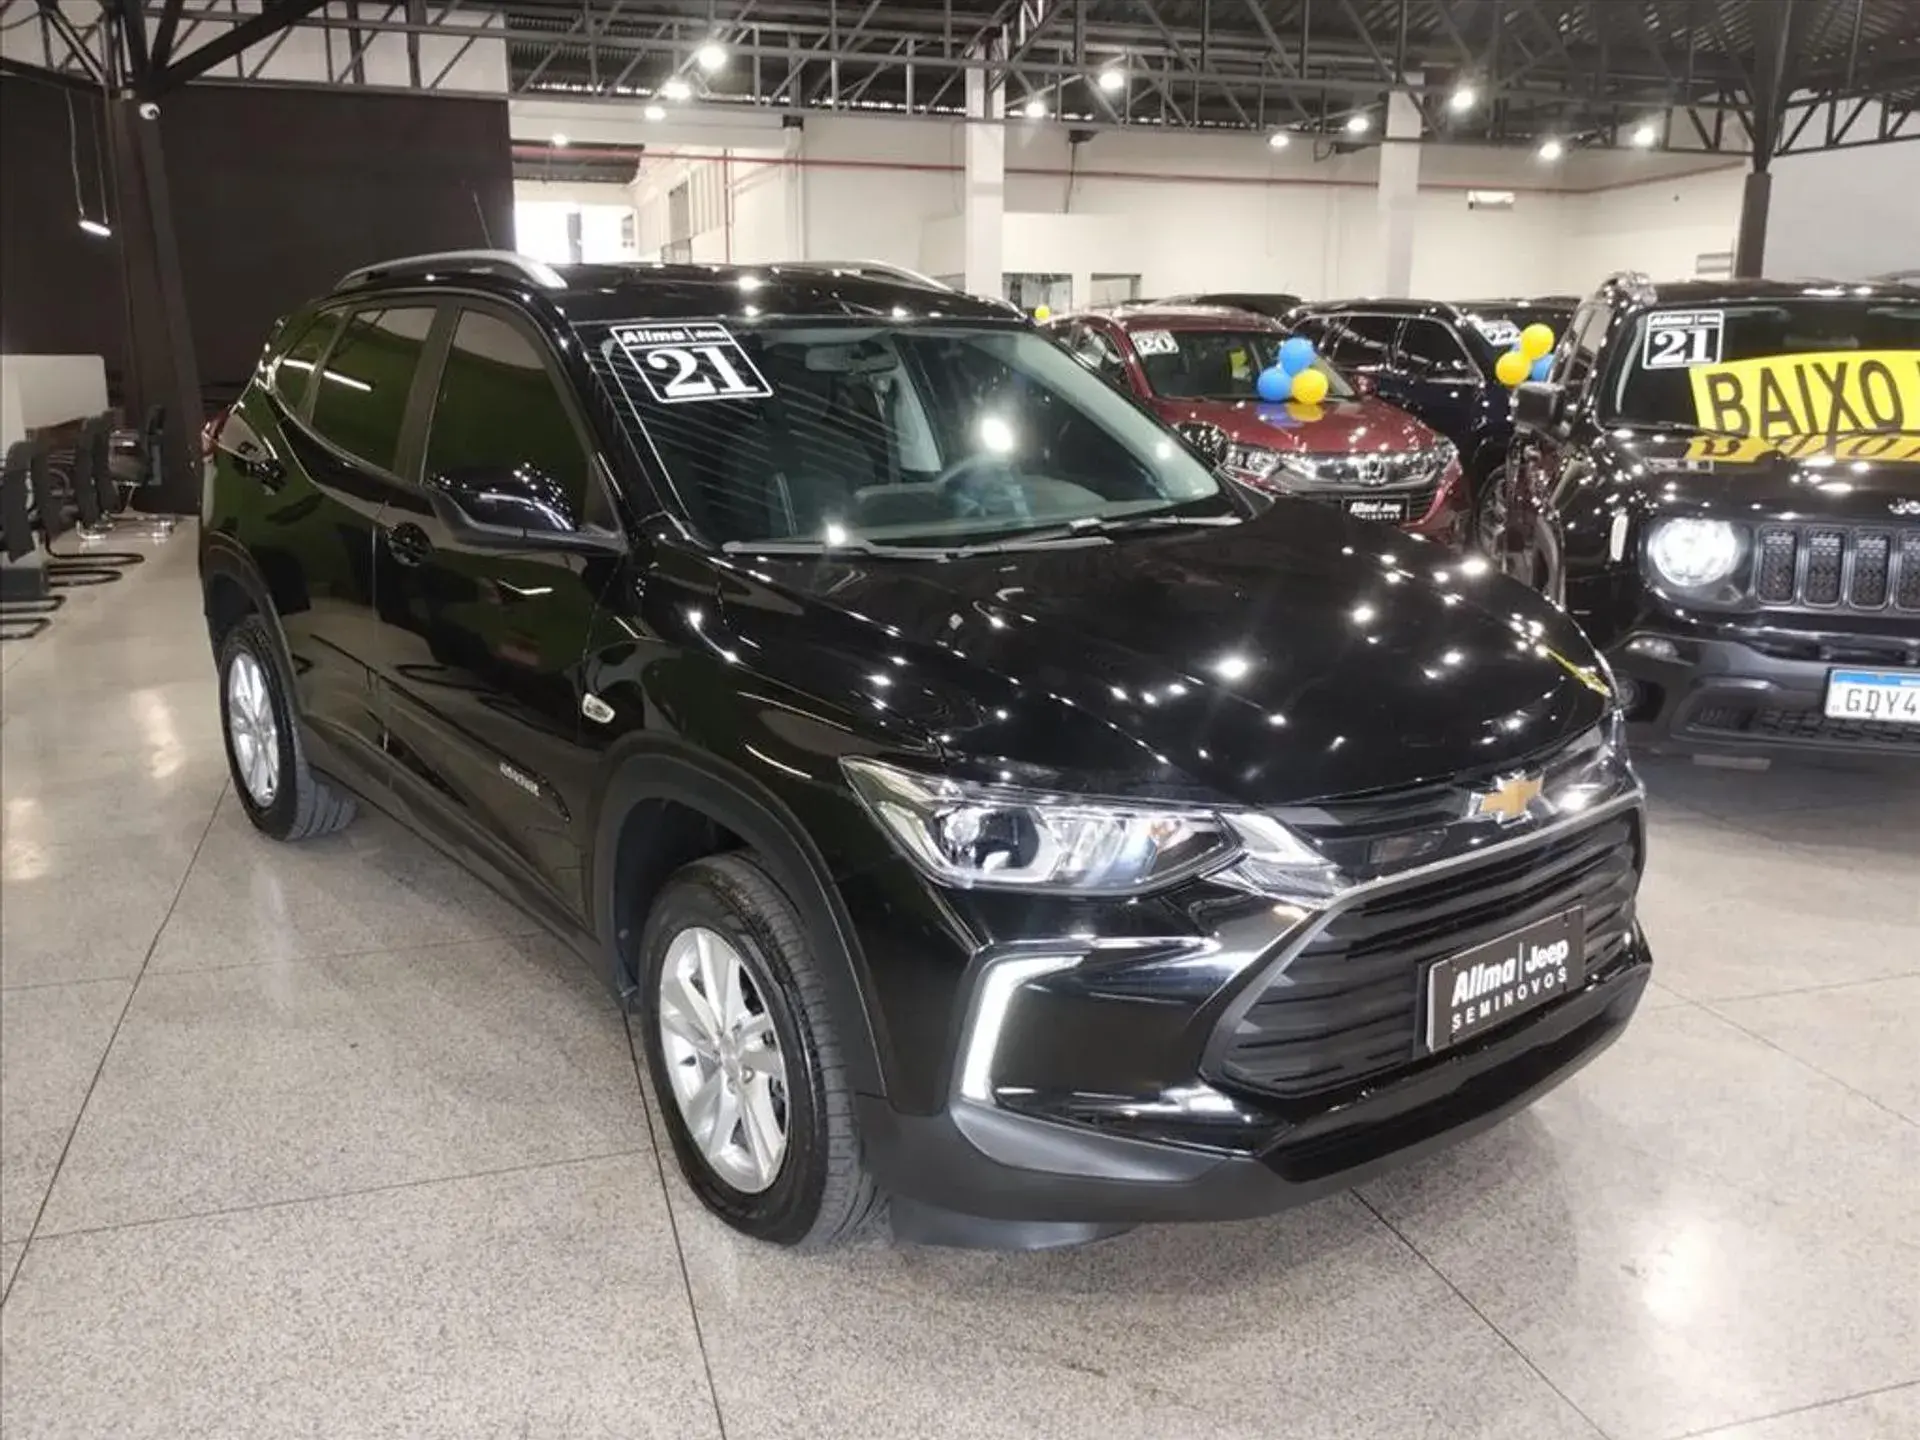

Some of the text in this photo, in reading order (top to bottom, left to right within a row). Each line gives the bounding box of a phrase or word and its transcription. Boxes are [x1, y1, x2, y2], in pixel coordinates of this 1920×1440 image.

[646, 346, 759, 398] 21
[1651, 329, 1713, 364] 21
[1706, 360, 1904, 438] BAIXO
[1525, 939, 1569, 974] Jeep
[1451, 966, 1568, 1032] SEMINOVOS
